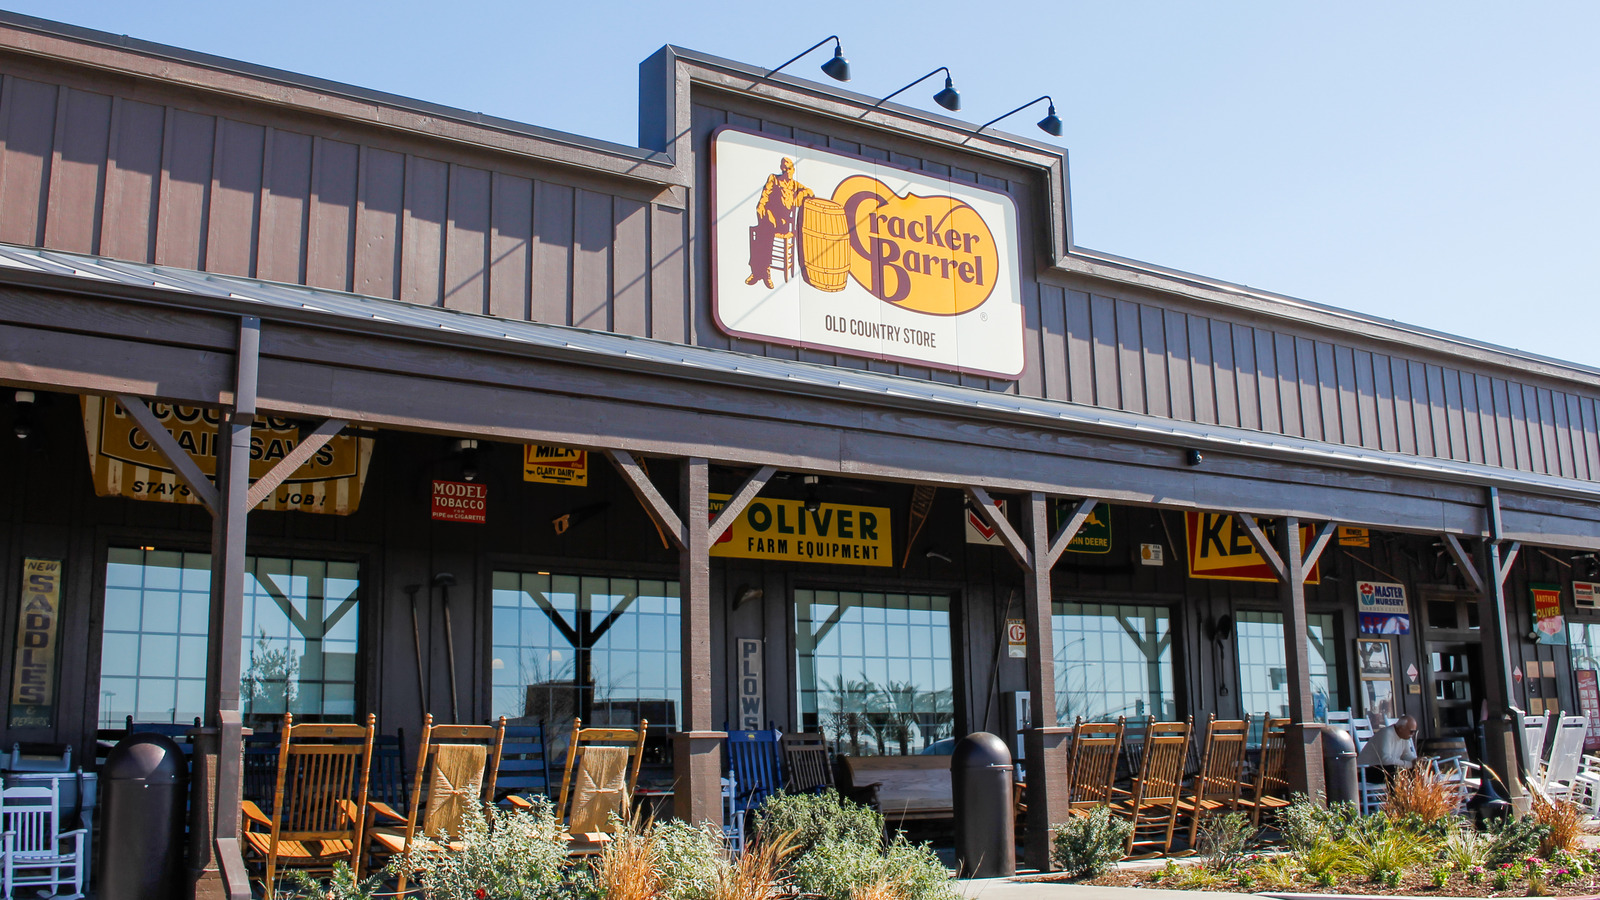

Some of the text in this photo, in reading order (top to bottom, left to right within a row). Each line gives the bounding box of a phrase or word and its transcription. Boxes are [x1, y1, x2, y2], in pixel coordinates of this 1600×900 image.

[844, 190, 981, 261] Cracker
[868, 236, 984, 302] Barrel
[825, 314, 936, 348] OLD COUNTRY STORE
[129, 426, 218, 456] CAI
[536, 445, 576, 458] MILK
[536, 466, 575, 478] CLARY DAIRY
[132, 480, 191, 497] STAYS
[433, 482, 486, 499] MODEL
[434, 496, 484, 510] TOBACCO
[454, 513, 486, 521] CIGARETTE
[747, 502, 878, 540] OLIVER
[748, 537, 879, 560] FARM EQUIPMENT
[1069, 537, 1108, 547] OHN DEERE
[27, 561, 58, 572] NEW
[1374, 585, 1404, 598] MASTER
[1536, 594, 1557, 603] ANOTHER
[1375, 597, 1405, 606] NURSERY
[1536, 606, 1560, 618] OLIVER
[19, 574, 54, 705] SADDLES
[741, 641, 760, 731] PLOWS
